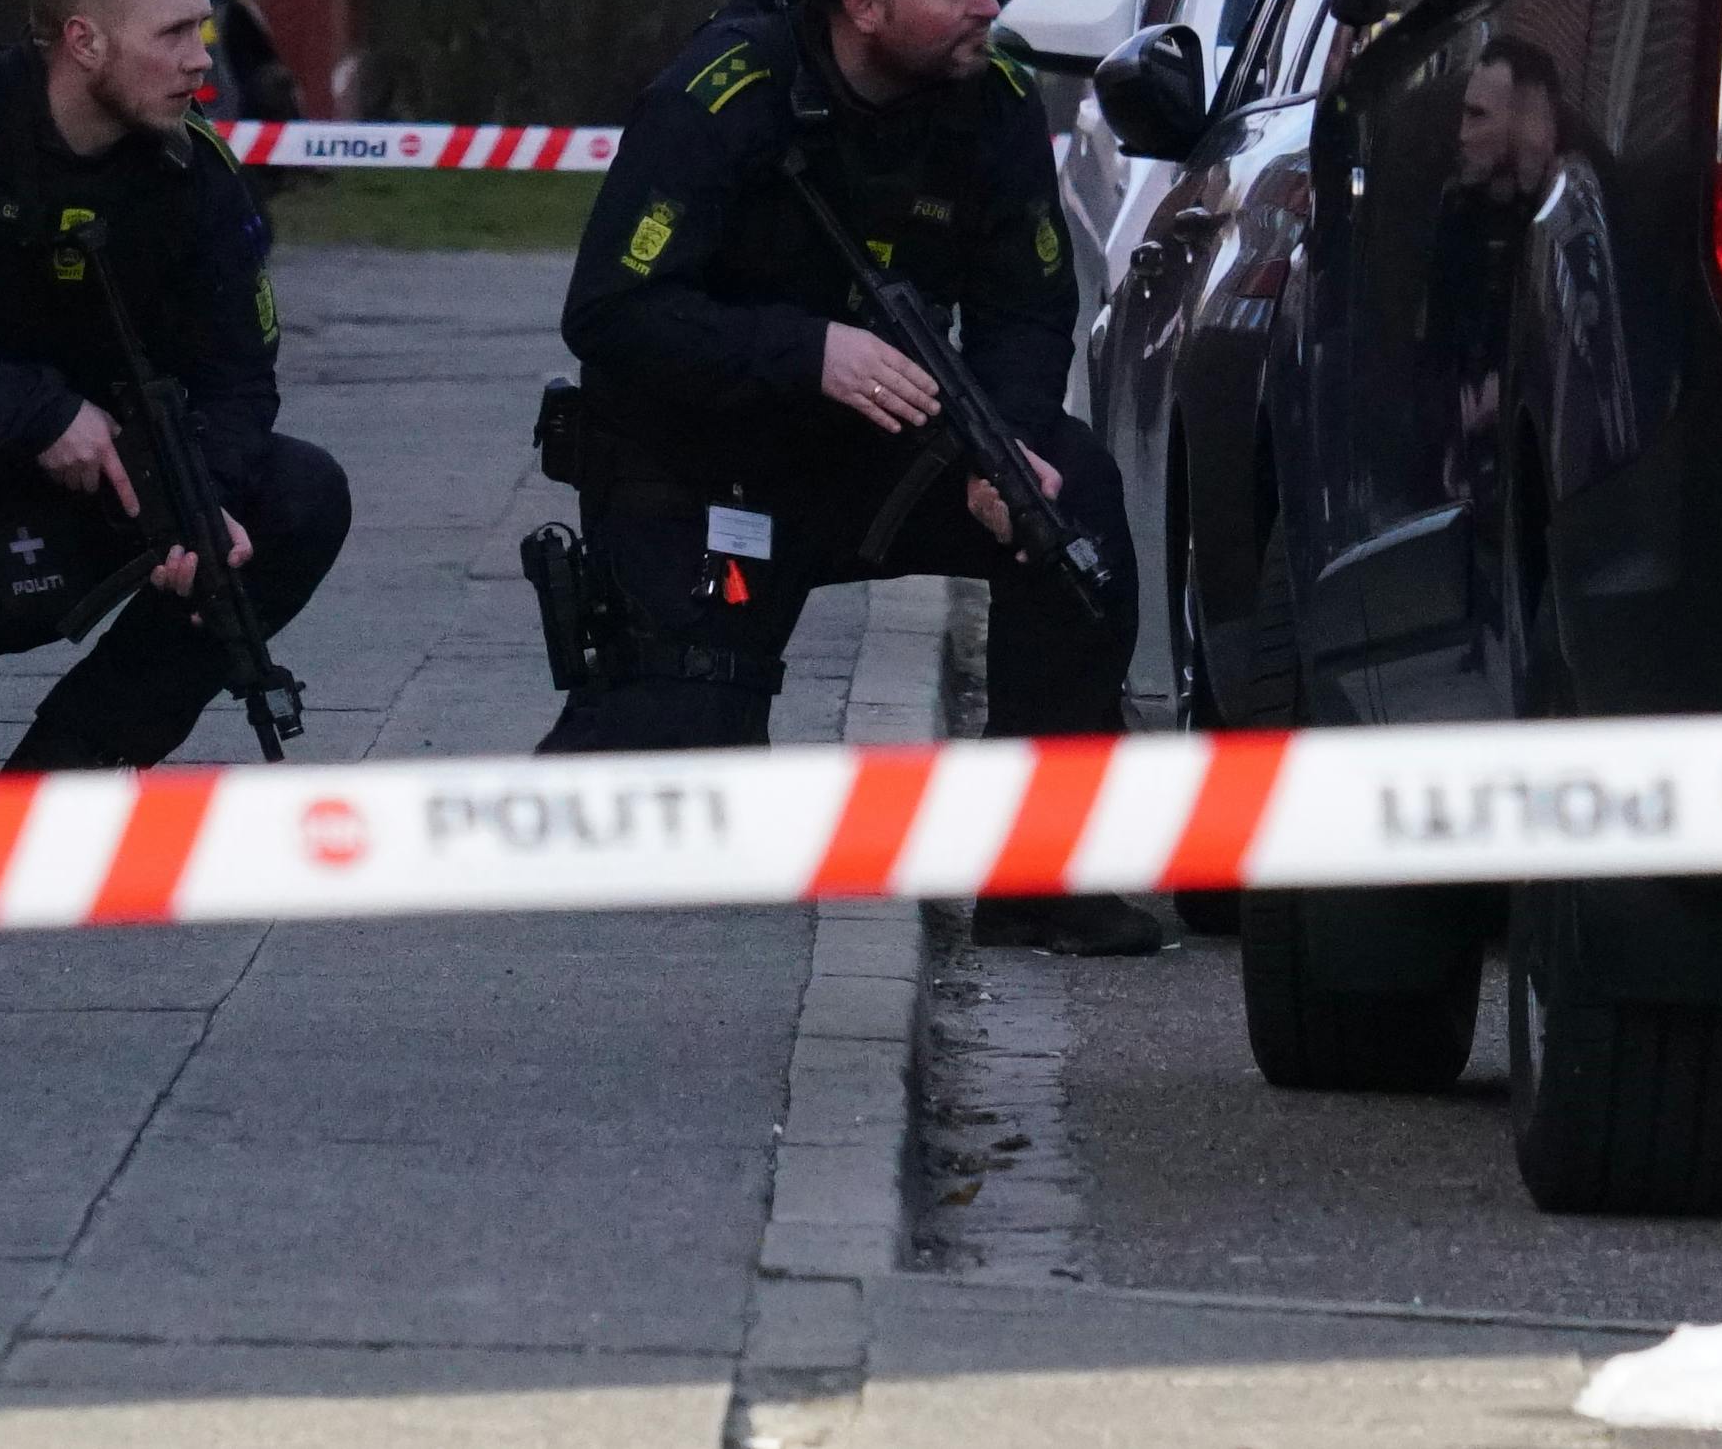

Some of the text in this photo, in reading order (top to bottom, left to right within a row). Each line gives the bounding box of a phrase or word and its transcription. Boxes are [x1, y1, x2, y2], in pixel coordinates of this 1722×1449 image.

[304, 139, 388, 158] POLITI
[11, 573, 64, 596] POLITI
[427, 789, 727, 850] POLITI
[1381, 778, 1674, 840] POLITI
